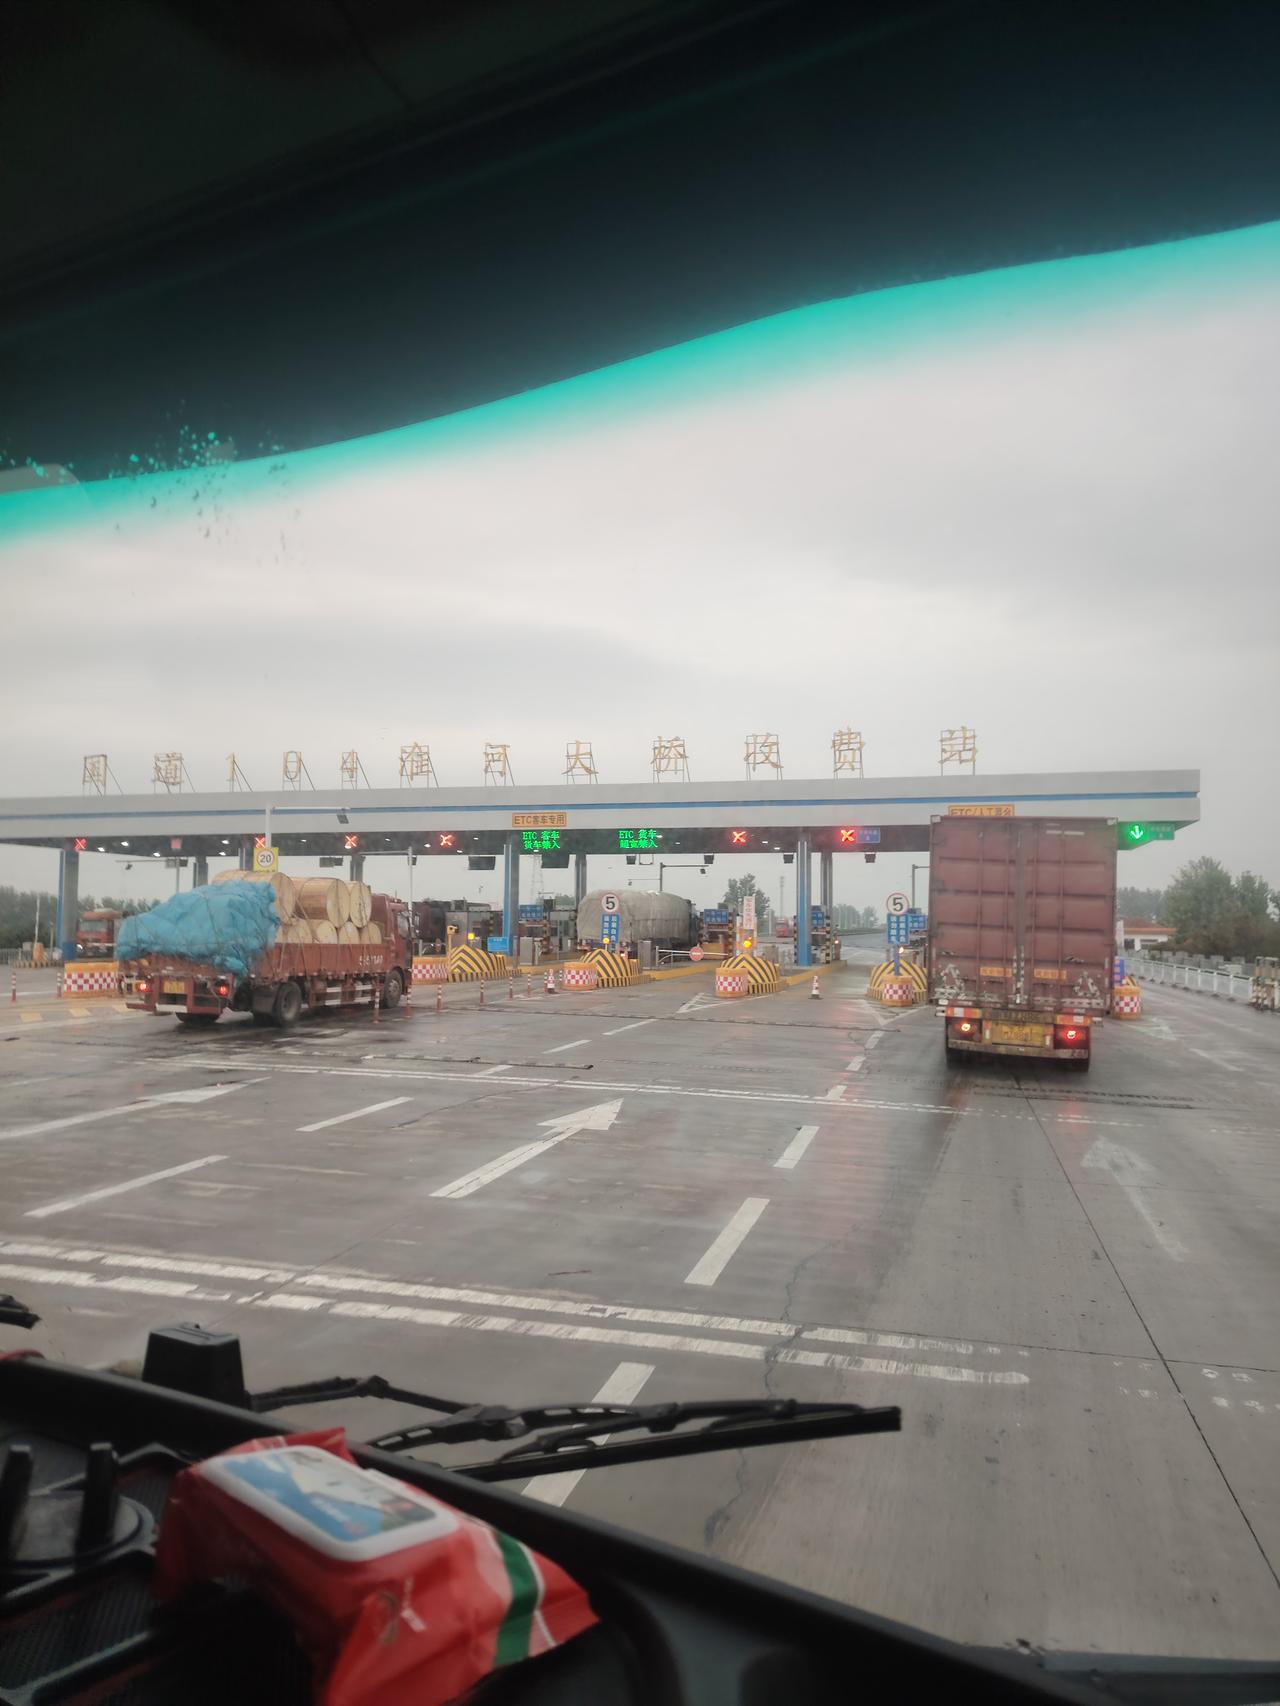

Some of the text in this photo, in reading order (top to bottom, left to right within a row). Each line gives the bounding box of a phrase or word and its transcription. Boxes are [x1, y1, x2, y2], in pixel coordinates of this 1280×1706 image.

[514, 814, 565, 825] ETC客车专用
[522, 831, 538, 840] ETC
[618, 830, 634, 839] ETC
[260, 854, 271, 863] 20
[605, 896, 615, 910] 5
[892, 897, 903, 912] 5
